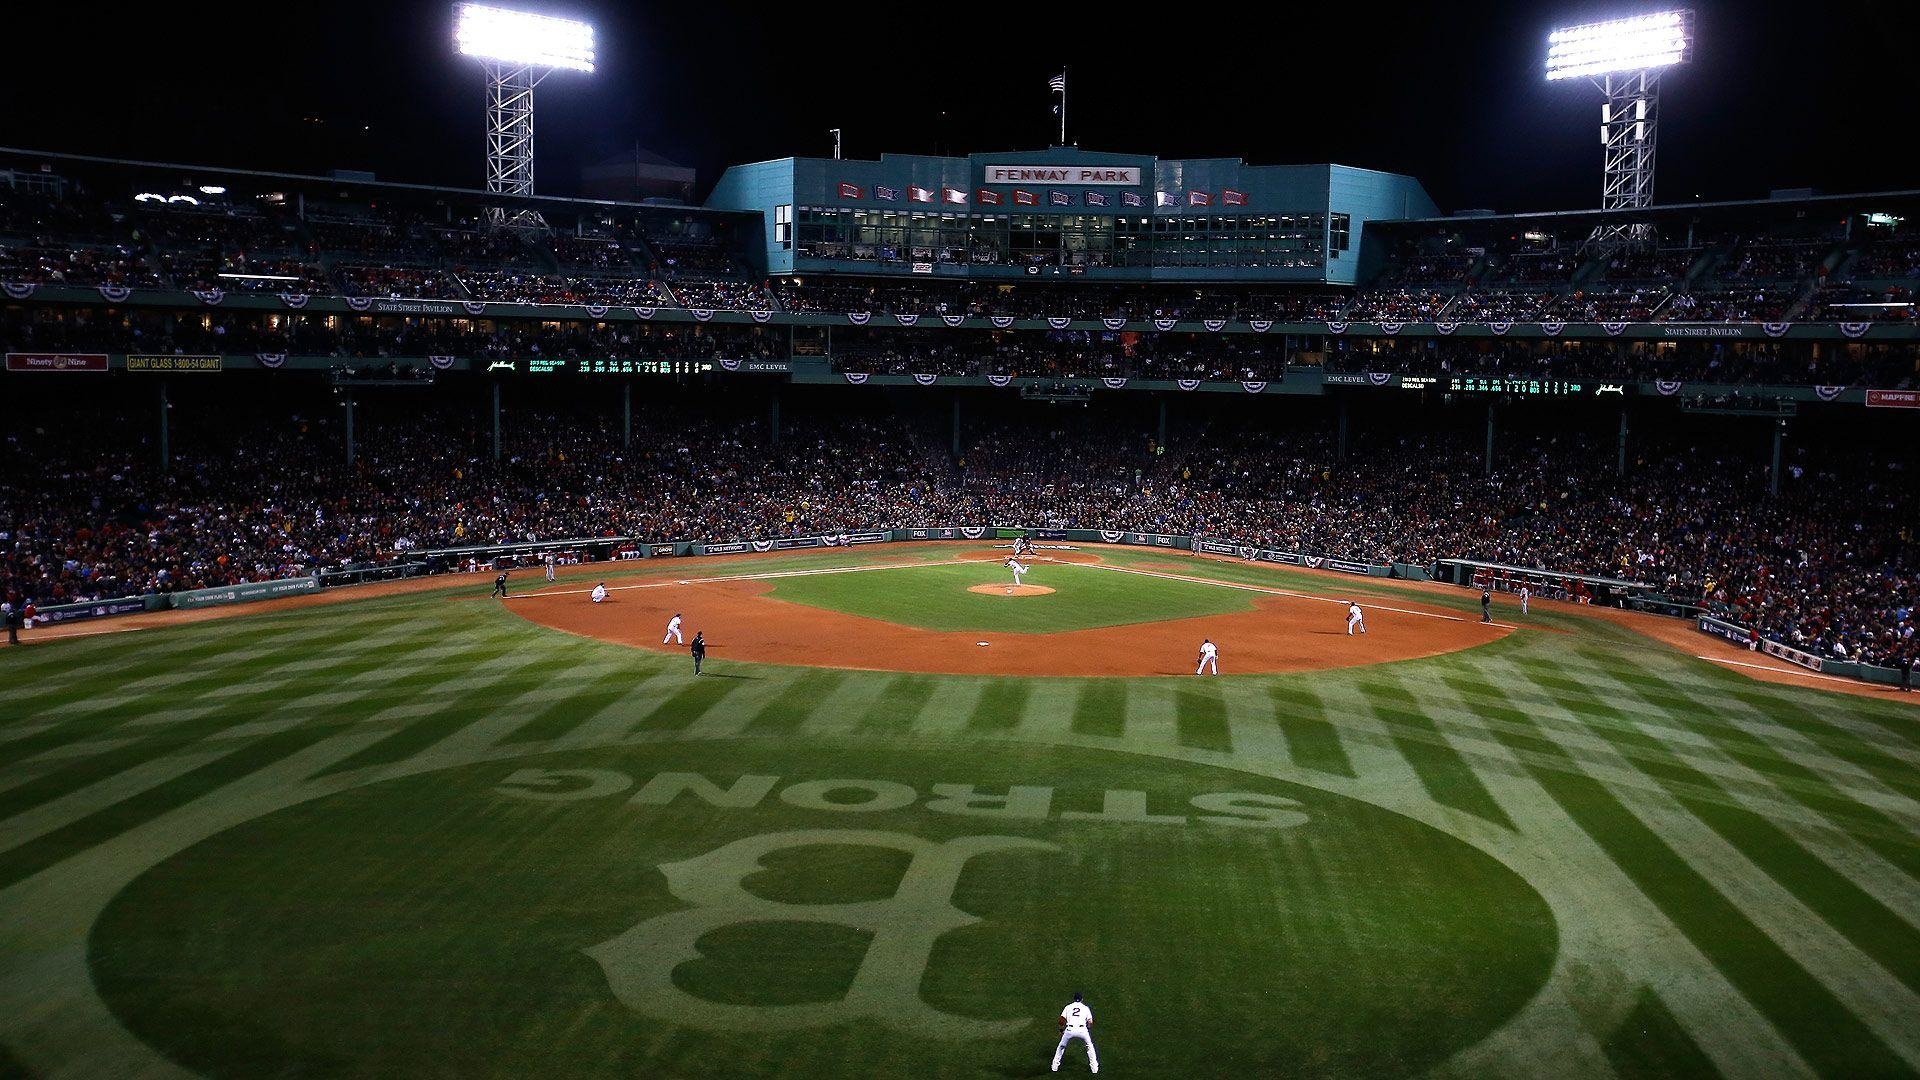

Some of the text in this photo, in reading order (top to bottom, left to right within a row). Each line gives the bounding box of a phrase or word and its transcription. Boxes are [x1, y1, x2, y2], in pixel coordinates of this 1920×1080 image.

[995, 169, 1130, 182] FENWAY PARK
[377, 302, 453, 313] STATE STREET PAVILION
[1664, 327, 1742, 336] STATE STREET PAVILION
[68, 358, 87, 366] Nine
[129, 359, 220, 369] GIANT GLASS 1-800-54 GIANT
[1570, 384, 1581, 392] 3RD
[1881, 393, 1916, 402] MAPFRE
[1157, 536, 1170, 544] FOX
[494, 768, 1312, 829] STRONG
[581, 828, 1063, 1040] B
[1072, 1007, 1080, 1017] 2
